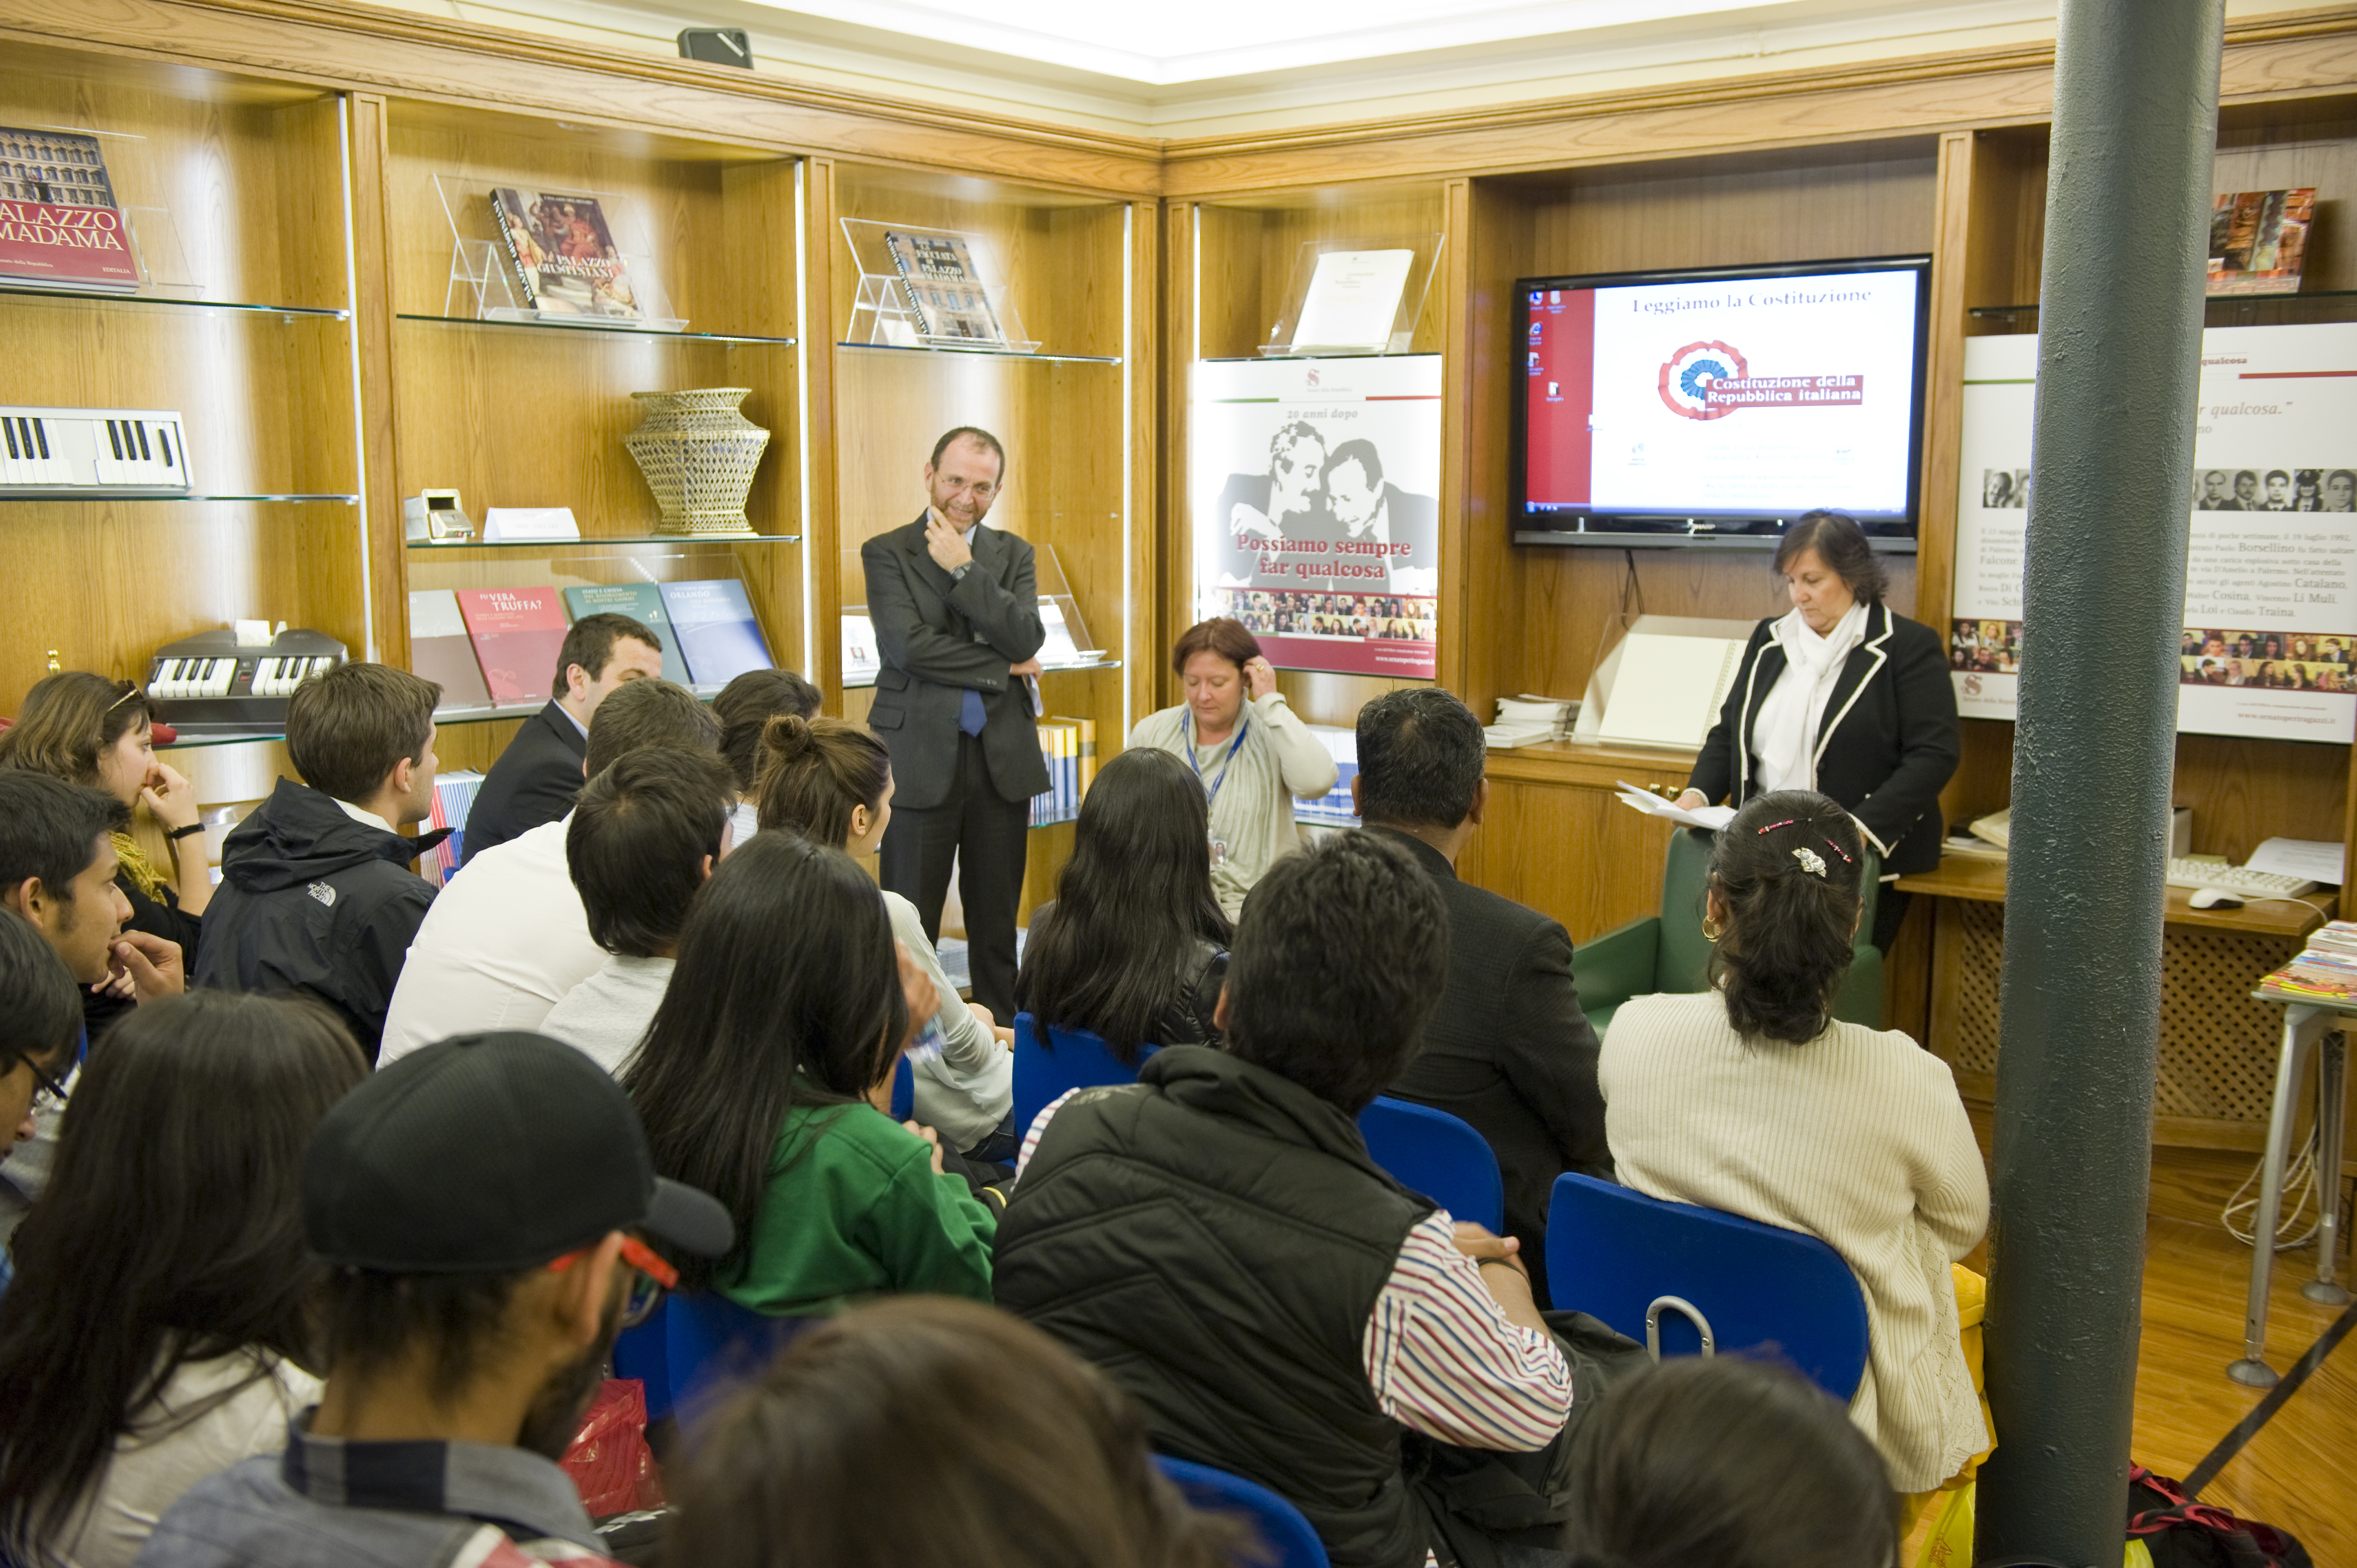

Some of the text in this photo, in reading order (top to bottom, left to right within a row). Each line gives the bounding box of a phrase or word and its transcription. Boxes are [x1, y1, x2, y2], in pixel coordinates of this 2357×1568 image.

[556, 254, 610, 267] PALAZZO
[537, 264, 614, 277] GIUSTINIANI
[1633, 289, 1872, 315] Leggiamo la Costituzione
[2201, 357, 2247, 366] qualcosa
[1712, 375, 1856, 391] Costituzione della
[1707, 388, 1861, 405] Repubblica italiana
[1287, 409, 1358, 420] 20 anni dopo
[2304, 533, 2327, 541] luglio
[1237, 534, 1412, 559] Possiamo sempre
[2238, 542, 2295, 553] Borsellino
[1260, 558, 1385, 579] far qualcosa
[2000, 583, 2011, 593] Di
[2258, 580, 2292, 588] Agostino
[488, 592, 516, 602] VERA
[670, 590, 710, 600] ORLANDO
[2256, 594, 2291, 602] Vincenzo
[2294, 592, 2304, 602] Li
[492, 600, 542, 612] TRUFFA?
[2201, 604, 2218, 614] Loi
[307, 883, 327, 896] NORTH
[319, 881, 331, 891] THE
[307, 890, 324, 901] FACE
